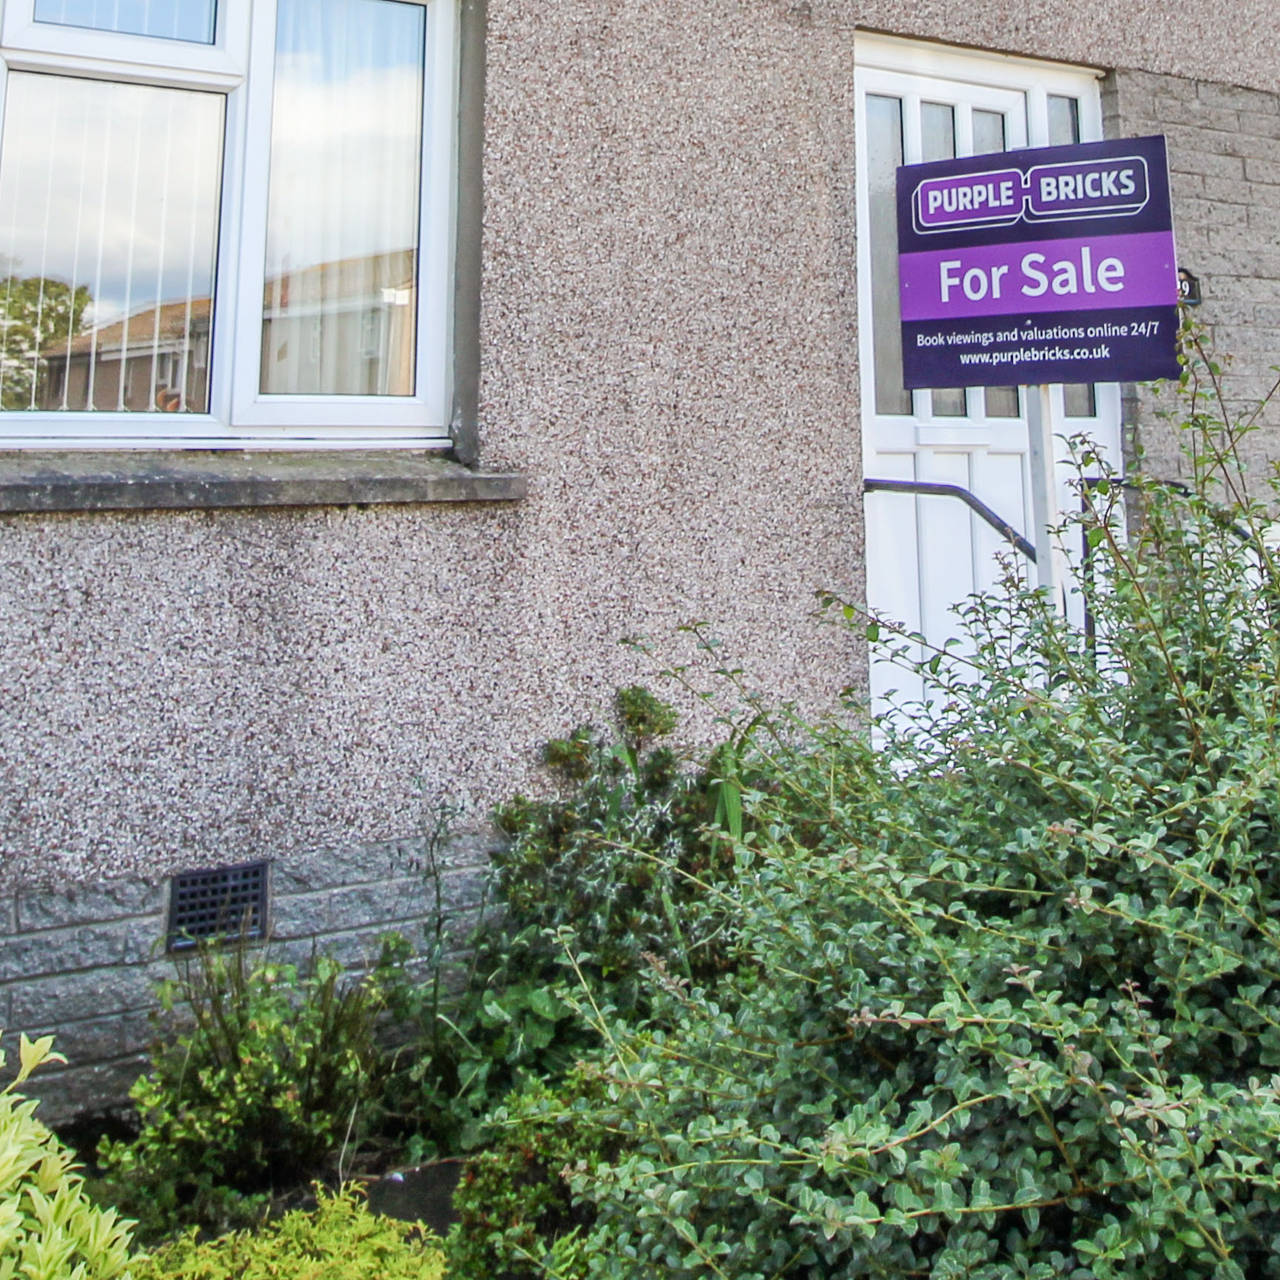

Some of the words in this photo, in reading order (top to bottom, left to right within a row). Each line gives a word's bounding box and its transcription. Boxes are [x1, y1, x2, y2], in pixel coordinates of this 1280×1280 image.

[928, 180, 1014, 215] PURPLE
[1040, 168, 1136, 202] BRICKS
[939, 260, 1009, 303] For
[1020, 246, 1125, 297] Sale
[916, 332, 945, 347] Book
[946, 330, 995, 347] viewings
[996, 327, 1018, 343] and
[1020, 326, 1085, 342] valuations
[1086, 322, 1128, 338] online
[1130, 321, 1160, 338] 24/7
[959, 343, 1110, 366] www.purplebricks.co.uk
